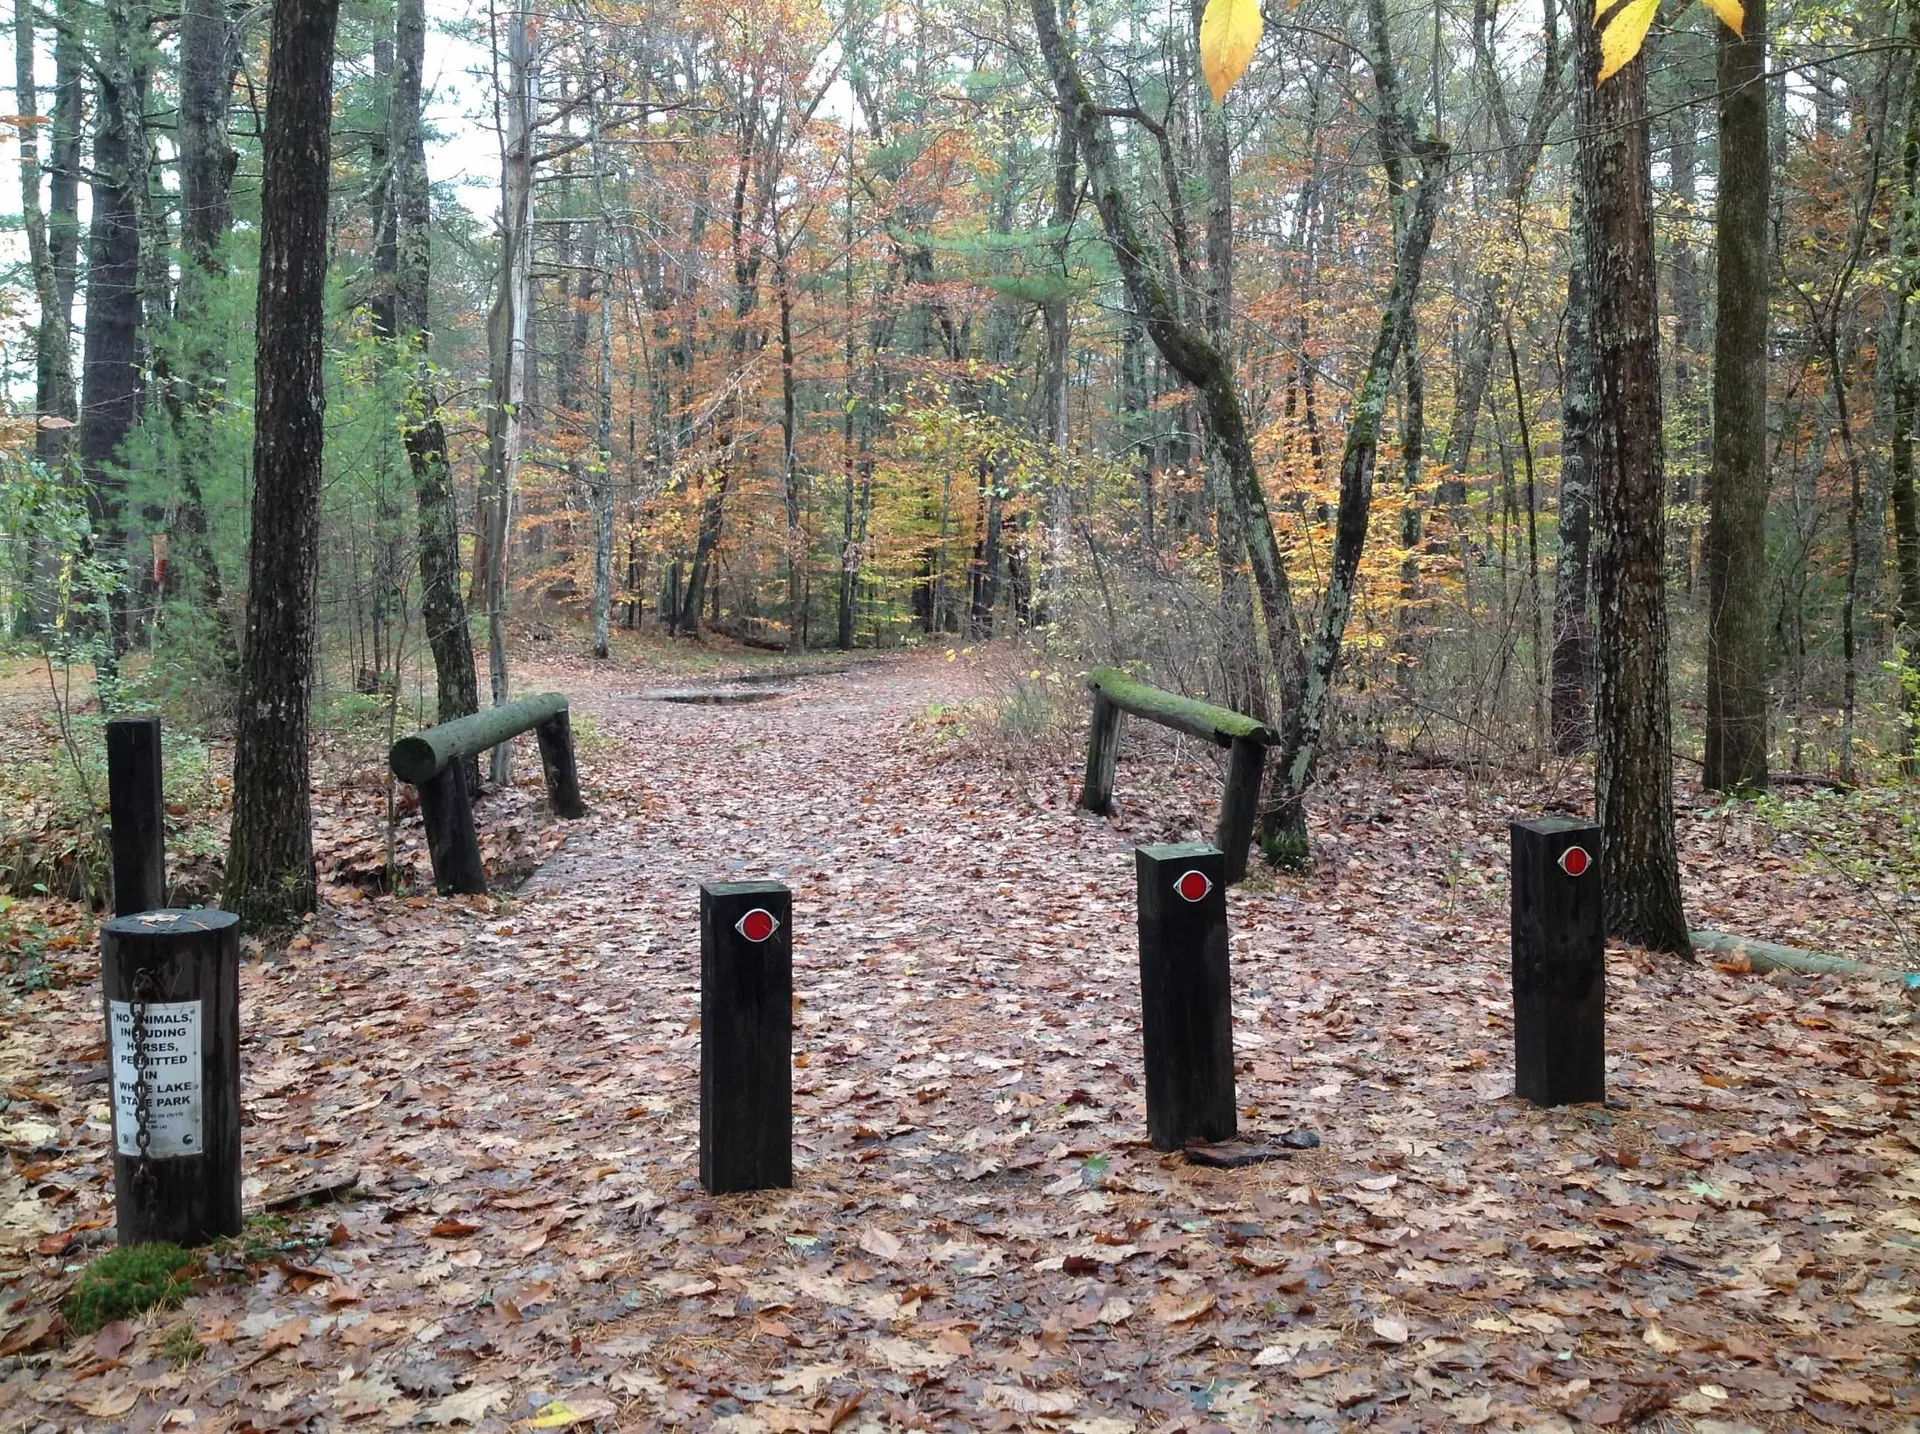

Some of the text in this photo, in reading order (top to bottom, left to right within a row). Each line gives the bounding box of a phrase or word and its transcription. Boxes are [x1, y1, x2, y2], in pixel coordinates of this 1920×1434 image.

[116, 1013, 193, 1024] NO NIMALS,
[121, 1028, 187, 1038] INUDING
[127, 1042, 179, 1053] HRSES,
[145, 1071, 158, 1080] IN
[157, 1081, 192, 1093] LAKE
[120, 1095, 191, 1107] STAE PARK
